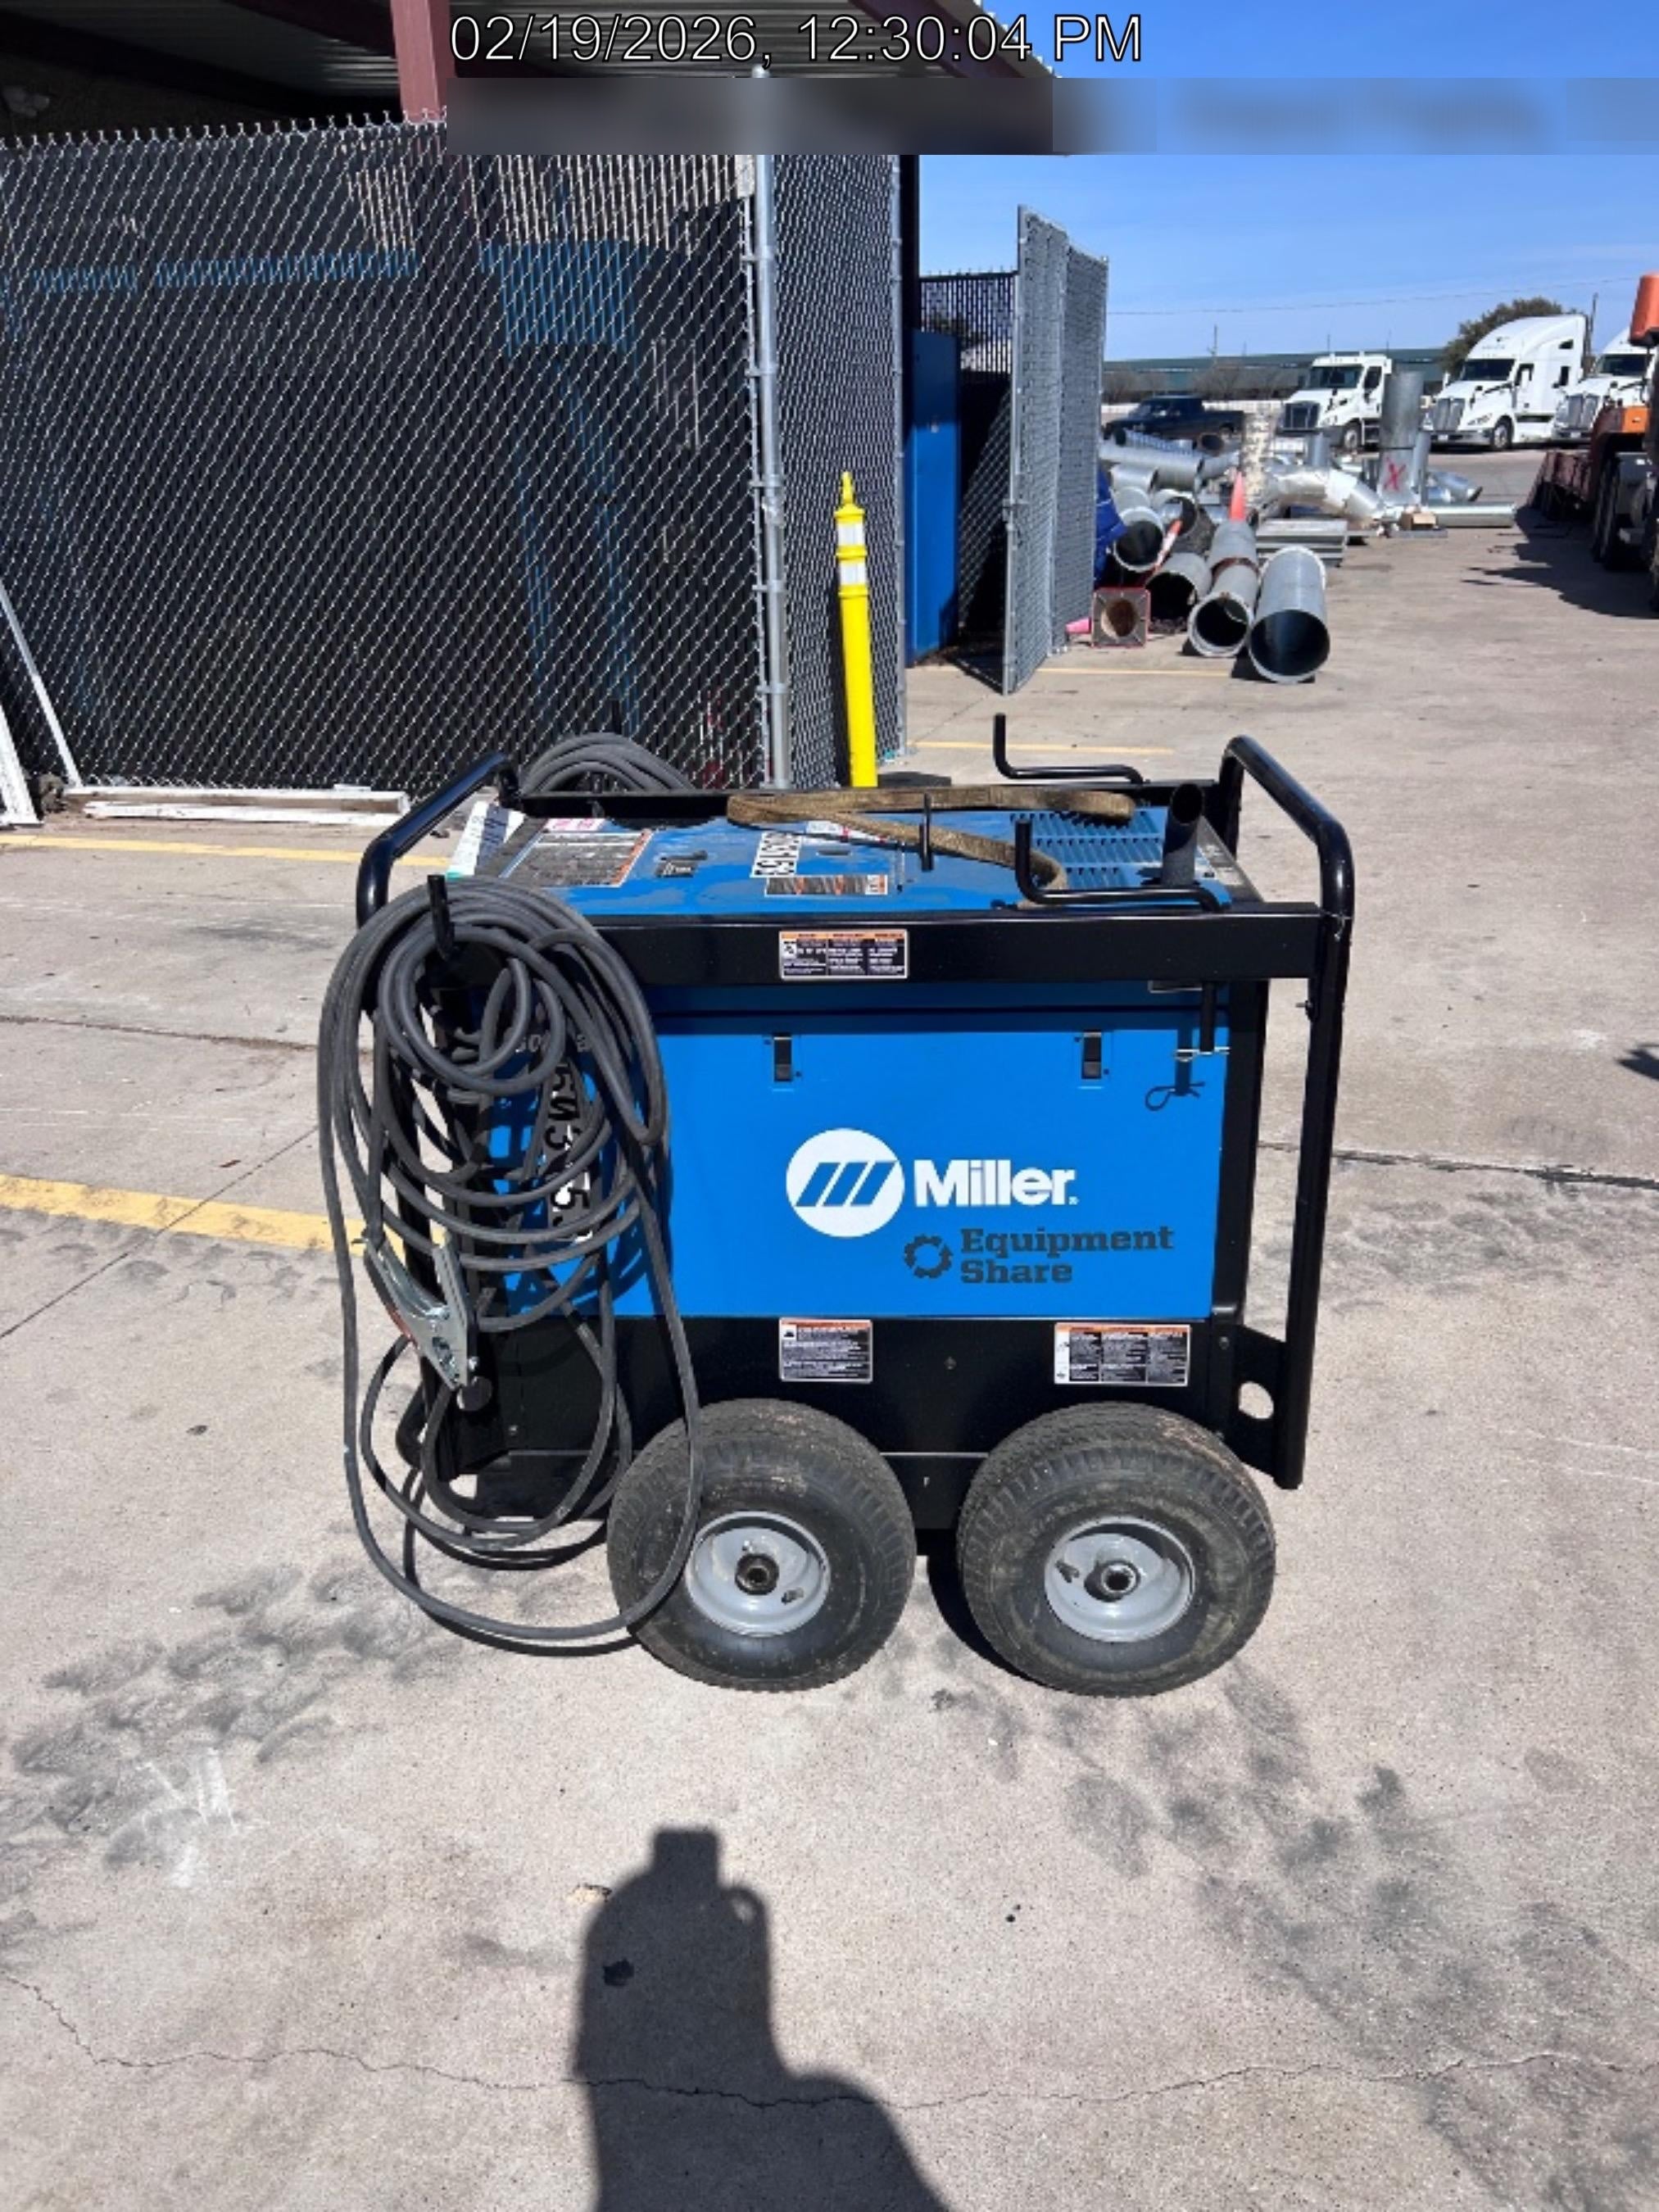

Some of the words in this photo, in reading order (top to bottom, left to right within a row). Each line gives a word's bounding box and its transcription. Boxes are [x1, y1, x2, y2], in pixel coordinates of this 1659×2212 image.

[913, 1158, 1077, 1208] Miller
[959, 1226, 1175, 1258] Equipment
[960, 1258, 1072, 1284] Share
